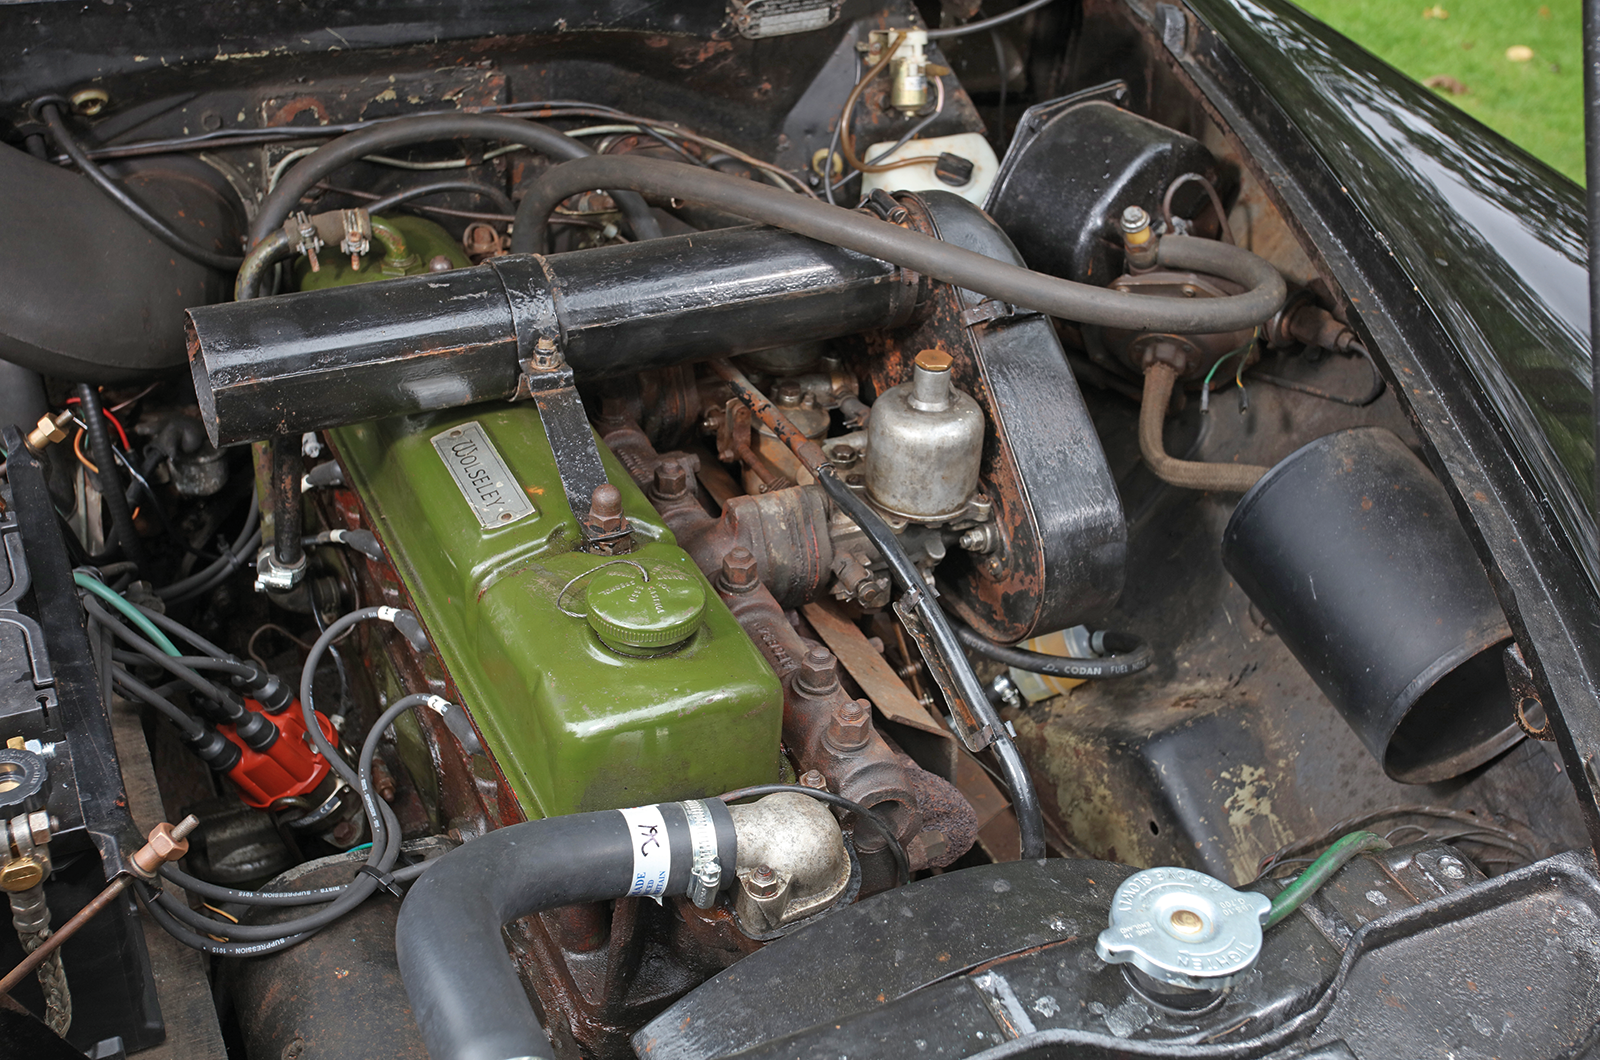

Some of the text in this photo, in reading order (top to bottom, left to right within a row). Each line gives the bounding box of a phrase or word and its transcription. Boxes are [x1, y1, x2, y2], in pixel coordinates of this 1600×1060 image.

[451, 439, 505, 507] WOLSELEY
[1063, 665, 1102, 675] CODAN
[262, 889, 310, 899] SUPPRESSION
[1118, 868, 1224, 912] REMOVE SLOWLY
[1119, 921, 1152, 935] ENGLAND
[1123, 926, 1156, 940] MADE IN
[211, 937, 285, 954] SUPPRESSION 1015
[1177, 940, 1255, 971] TIGHTEN
